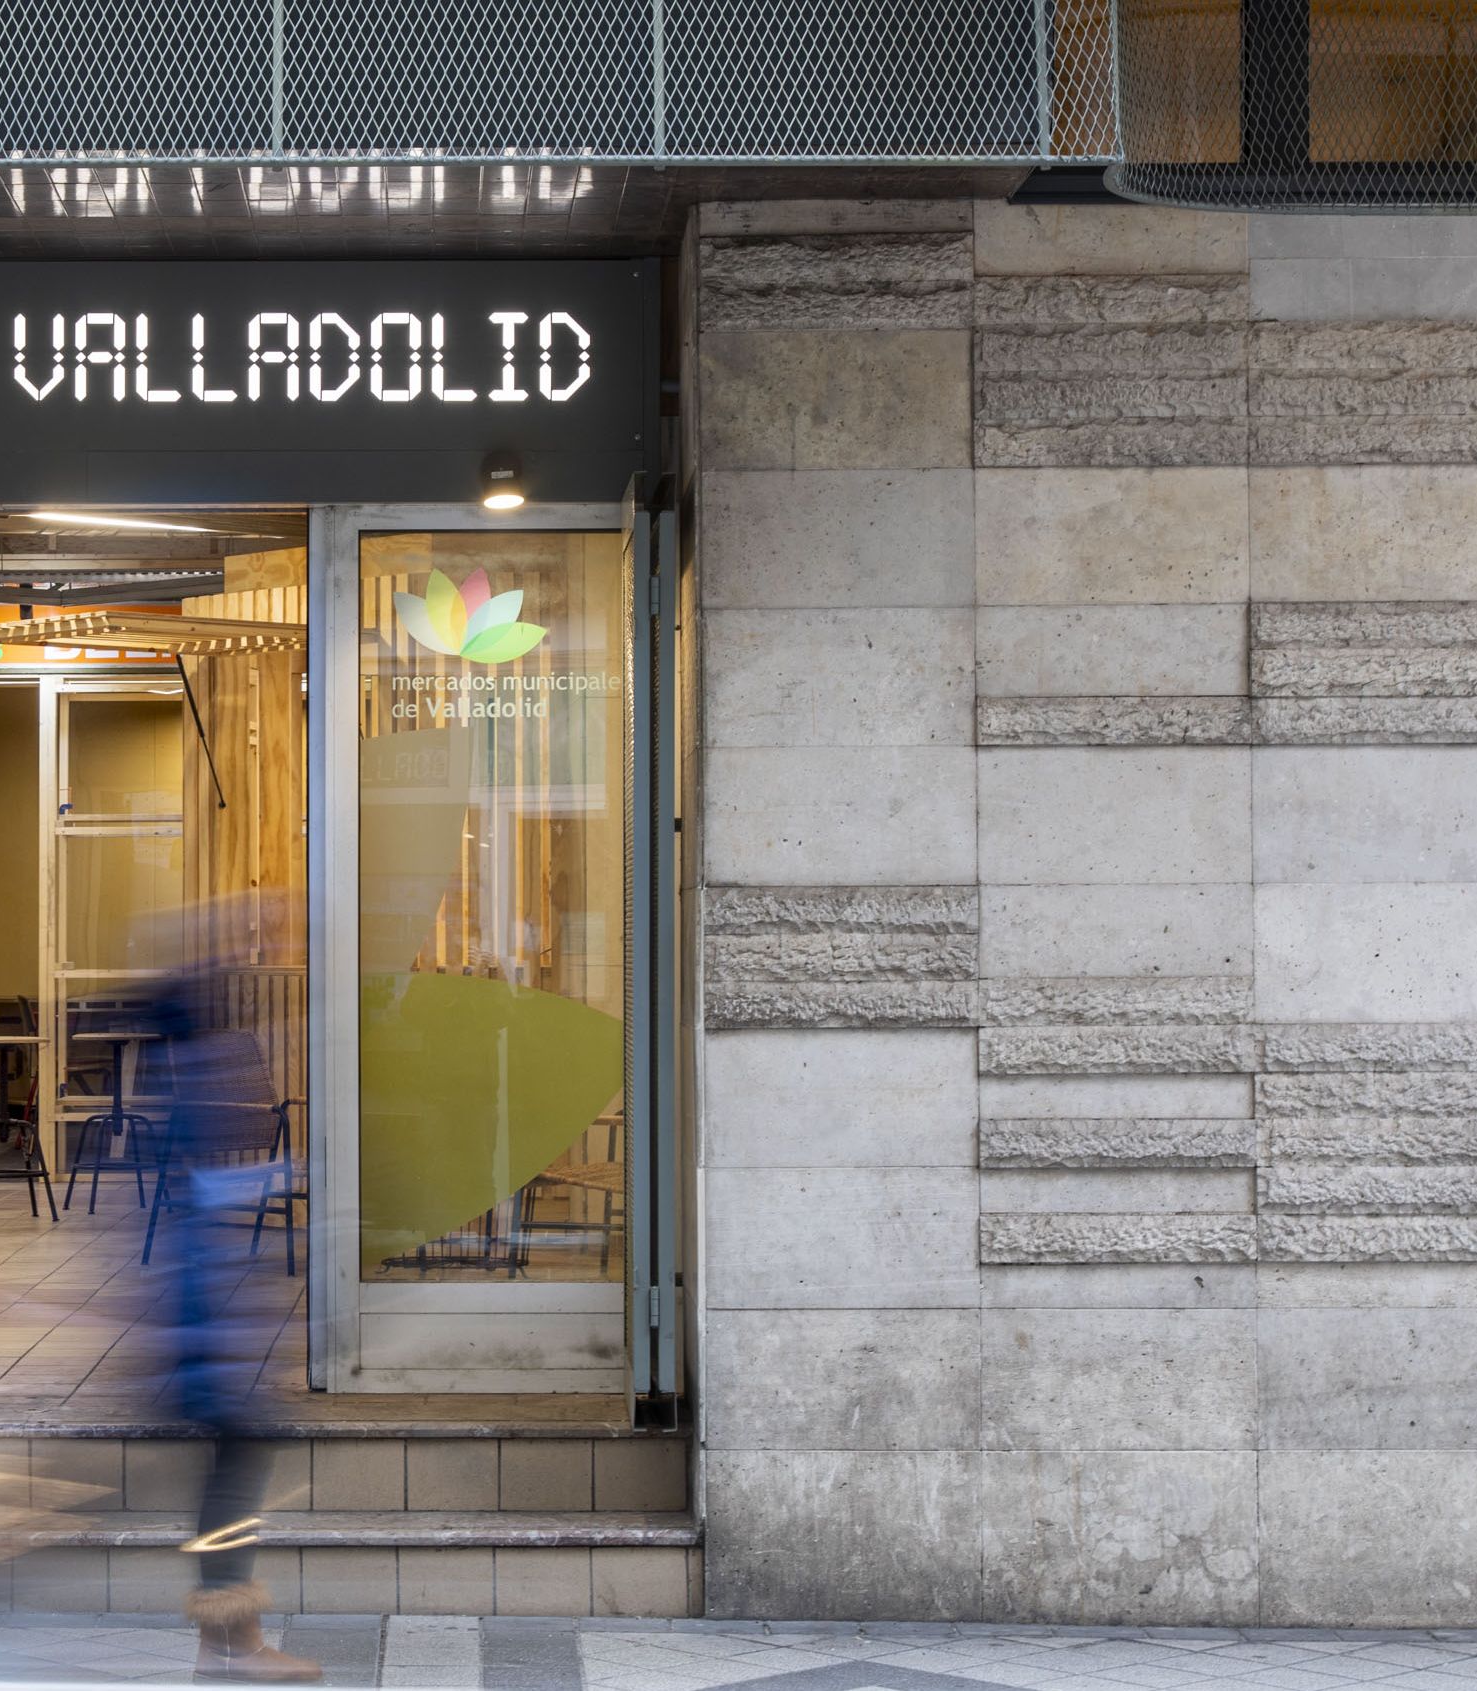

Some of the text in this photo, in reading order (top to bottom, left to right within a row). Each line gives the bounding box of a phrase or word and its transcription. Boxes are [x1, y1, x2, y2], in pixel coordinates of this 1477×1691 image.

[13, 311, 591, 402] VALLADOLID
[392, 671, 621, 694] mercados municipale
[392, 697, 548, 718] de Valladolid
